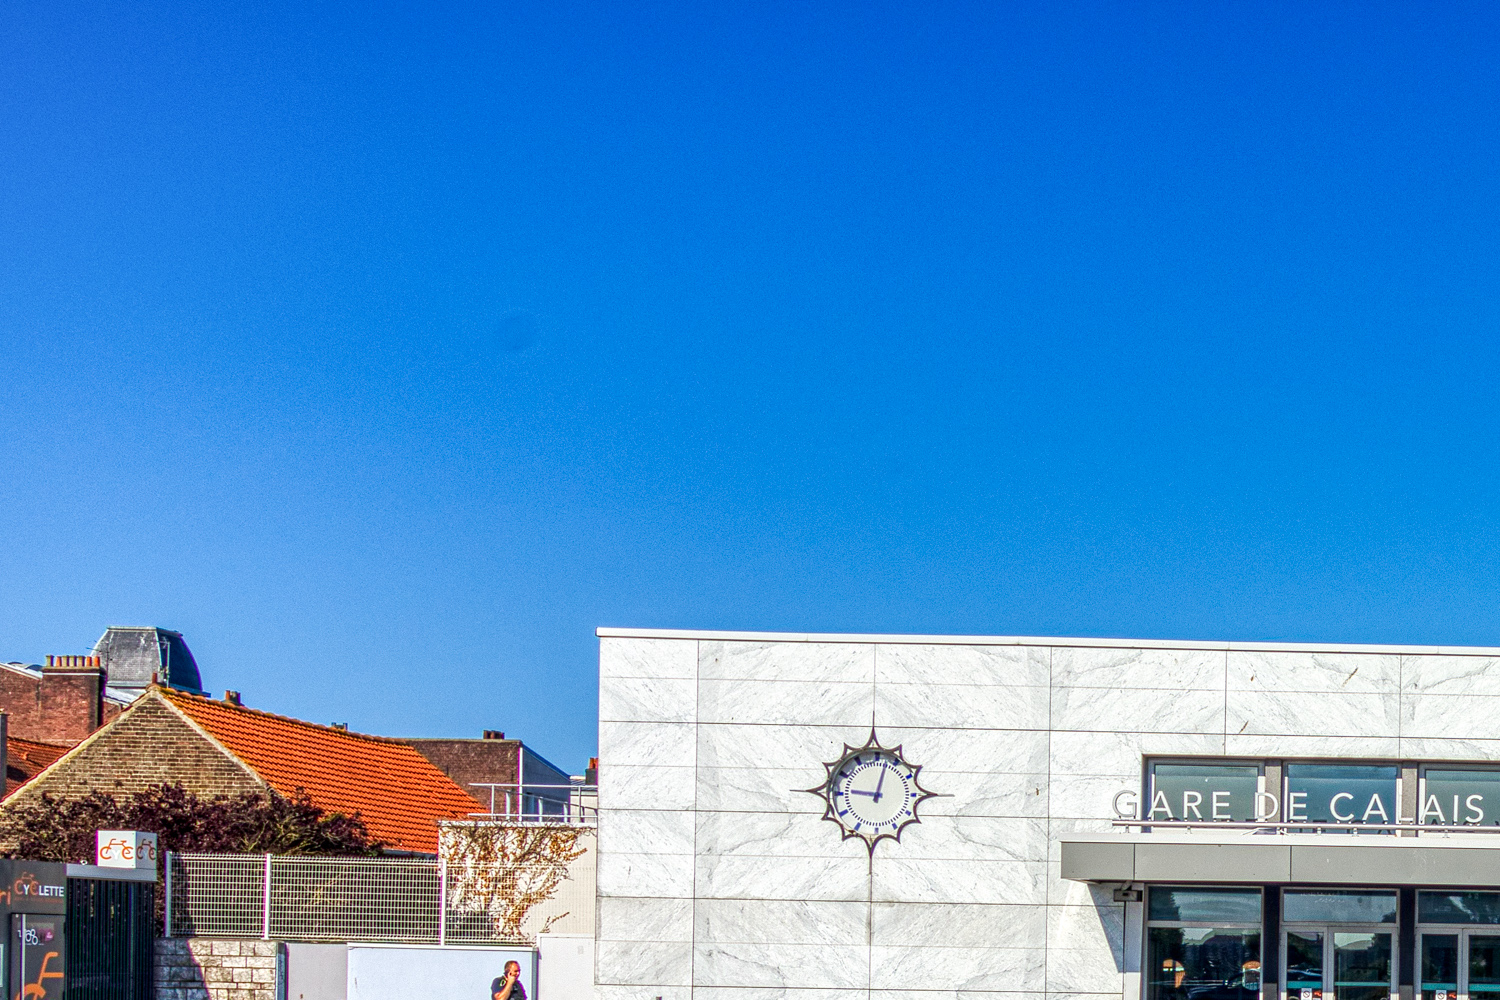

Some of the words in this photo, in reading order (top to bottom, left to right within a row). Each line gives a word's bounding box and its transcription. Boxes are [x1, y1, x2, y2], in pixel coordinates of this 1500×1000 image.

[1112, 790, 1231, 820] GARE
[1255, 792, 1308, 821] DE
[1329, 792, 1484, 824] CALAIS
